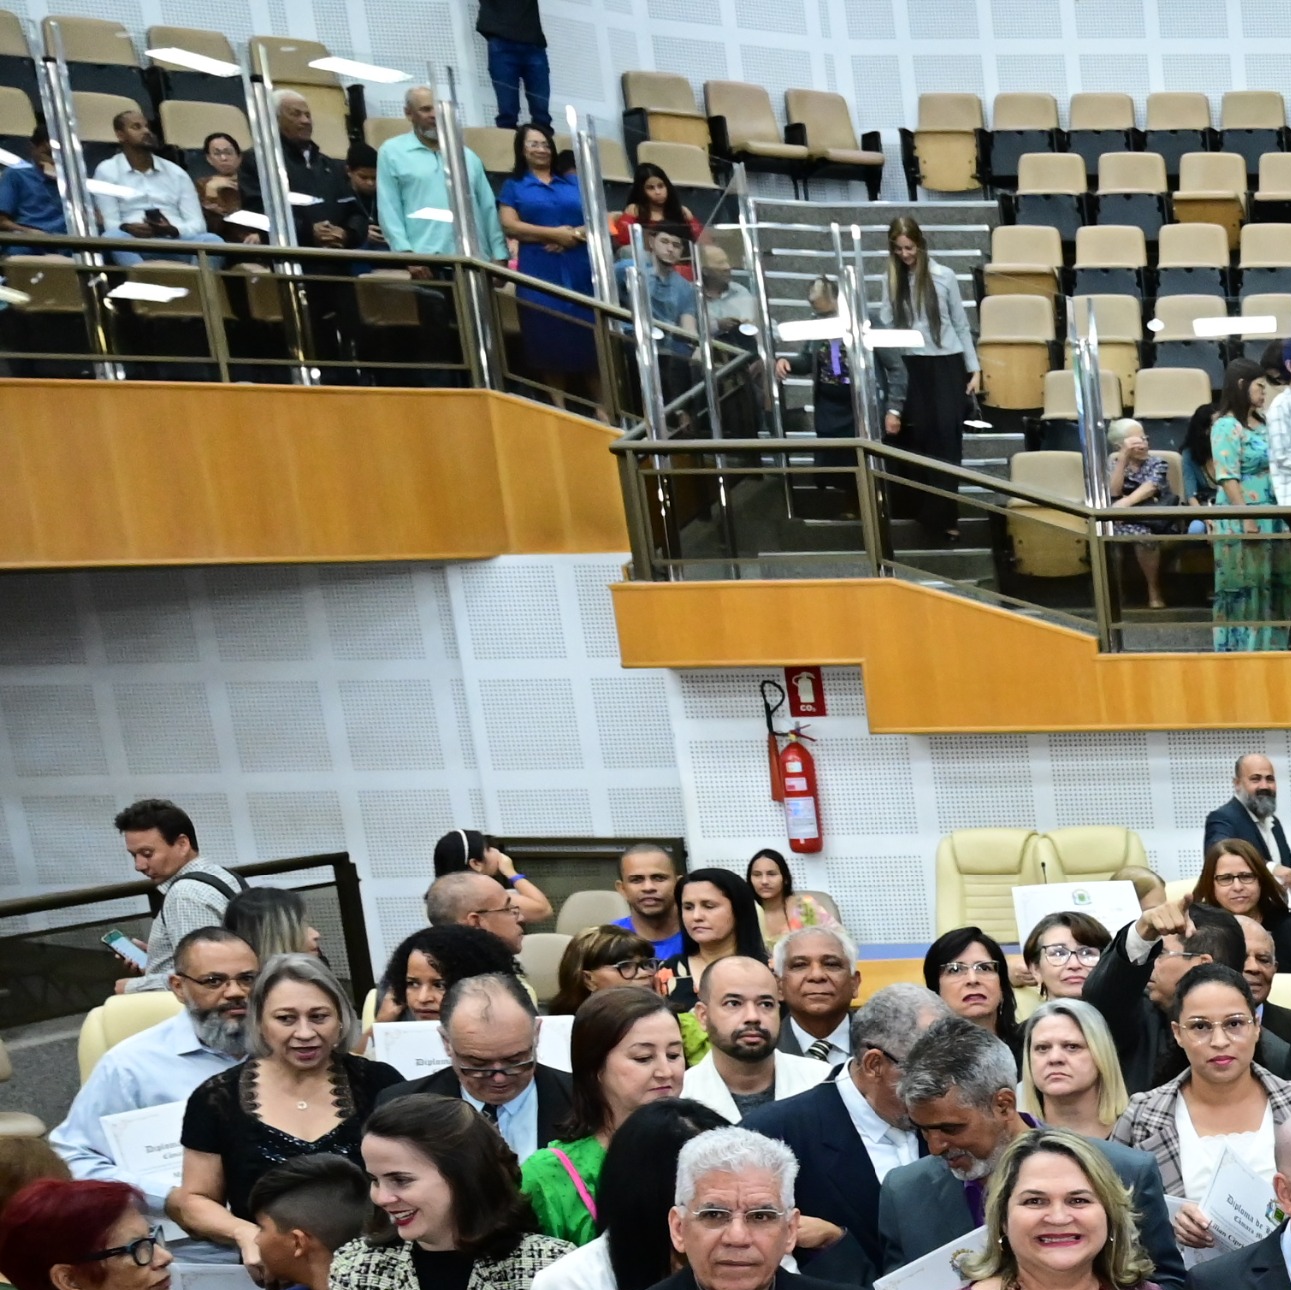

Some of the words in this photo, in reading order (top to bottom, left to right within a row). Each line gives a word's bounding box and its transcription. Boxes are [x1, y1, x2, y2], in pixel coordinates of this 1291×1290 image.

[1226, 1193, 1254, 1223] Diploma
[1254, 1218, 1263, 1229] de
[1233, 1215, 1254, 1234] Câmara
